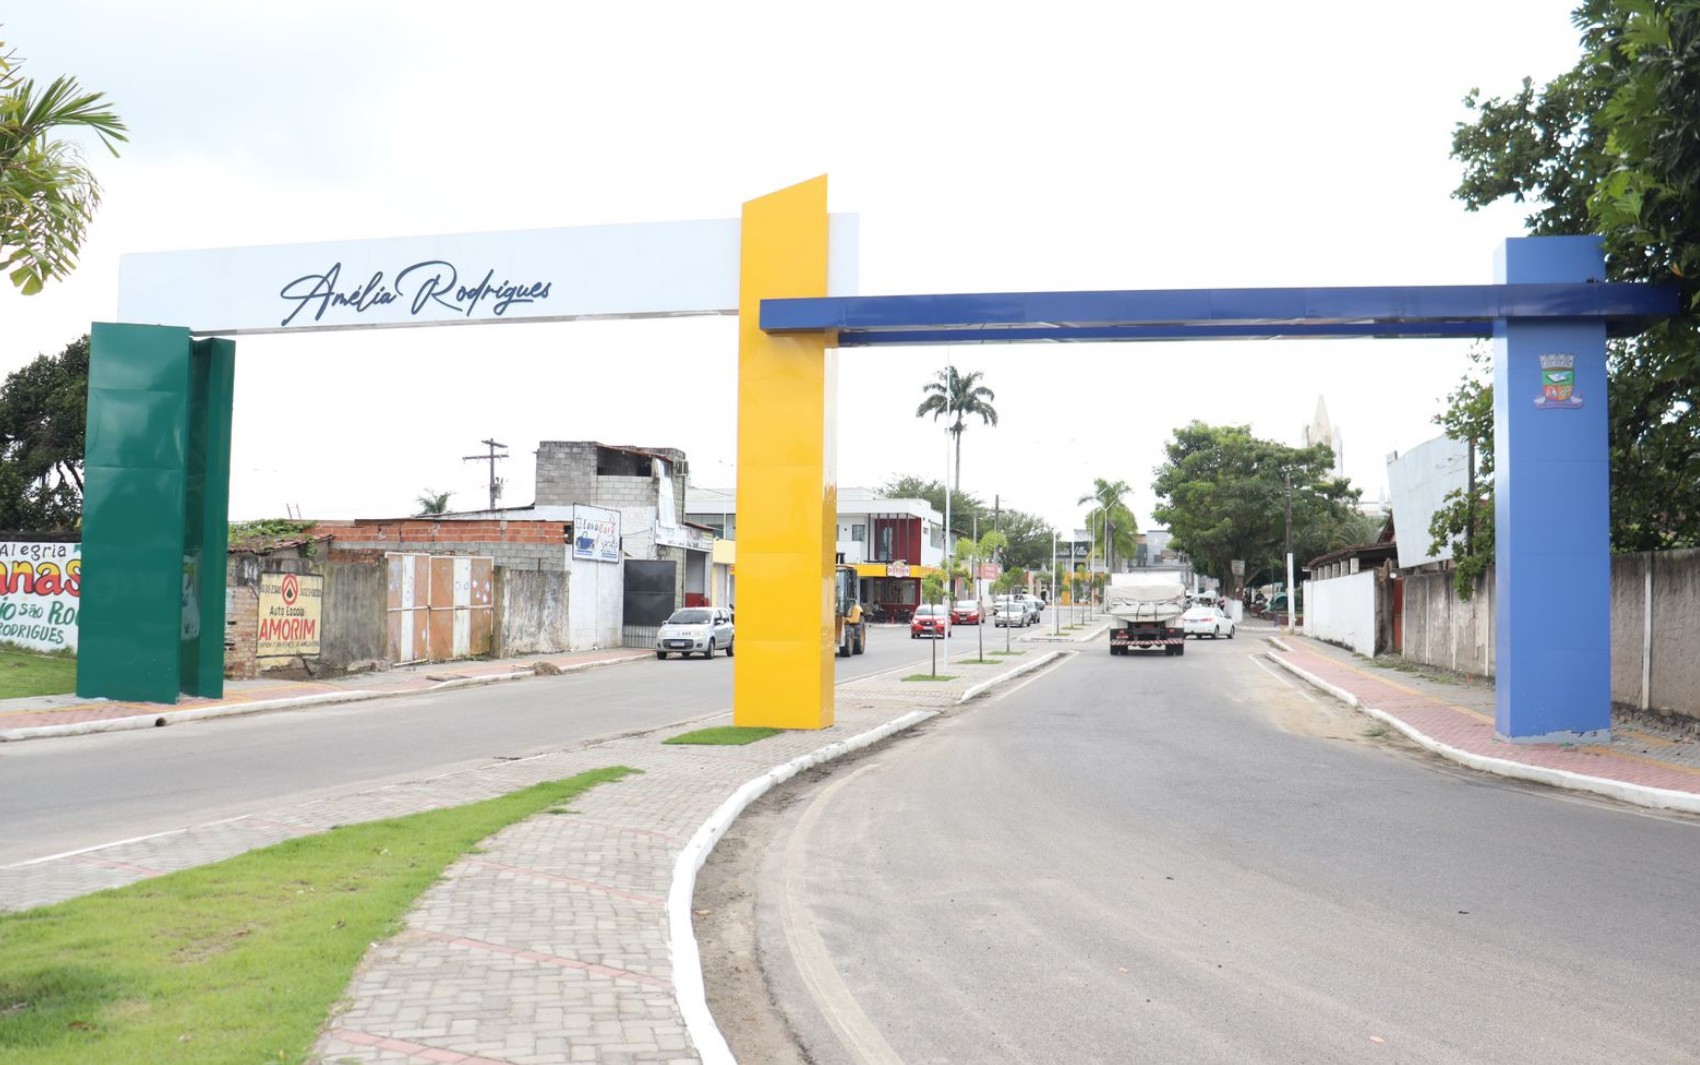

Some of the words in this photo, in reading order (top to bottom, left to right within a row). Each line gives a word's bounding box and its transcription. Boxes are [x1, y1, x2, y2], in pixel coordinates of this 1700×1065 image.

[280, 262, 398, 326] Amélia
[394, 260, 552, 316] Rodrigues
[0, 543, 66, 561] Alegria
[269, 605, 285, 616] Auto
[259, 618, 315, 641] AMORIM
